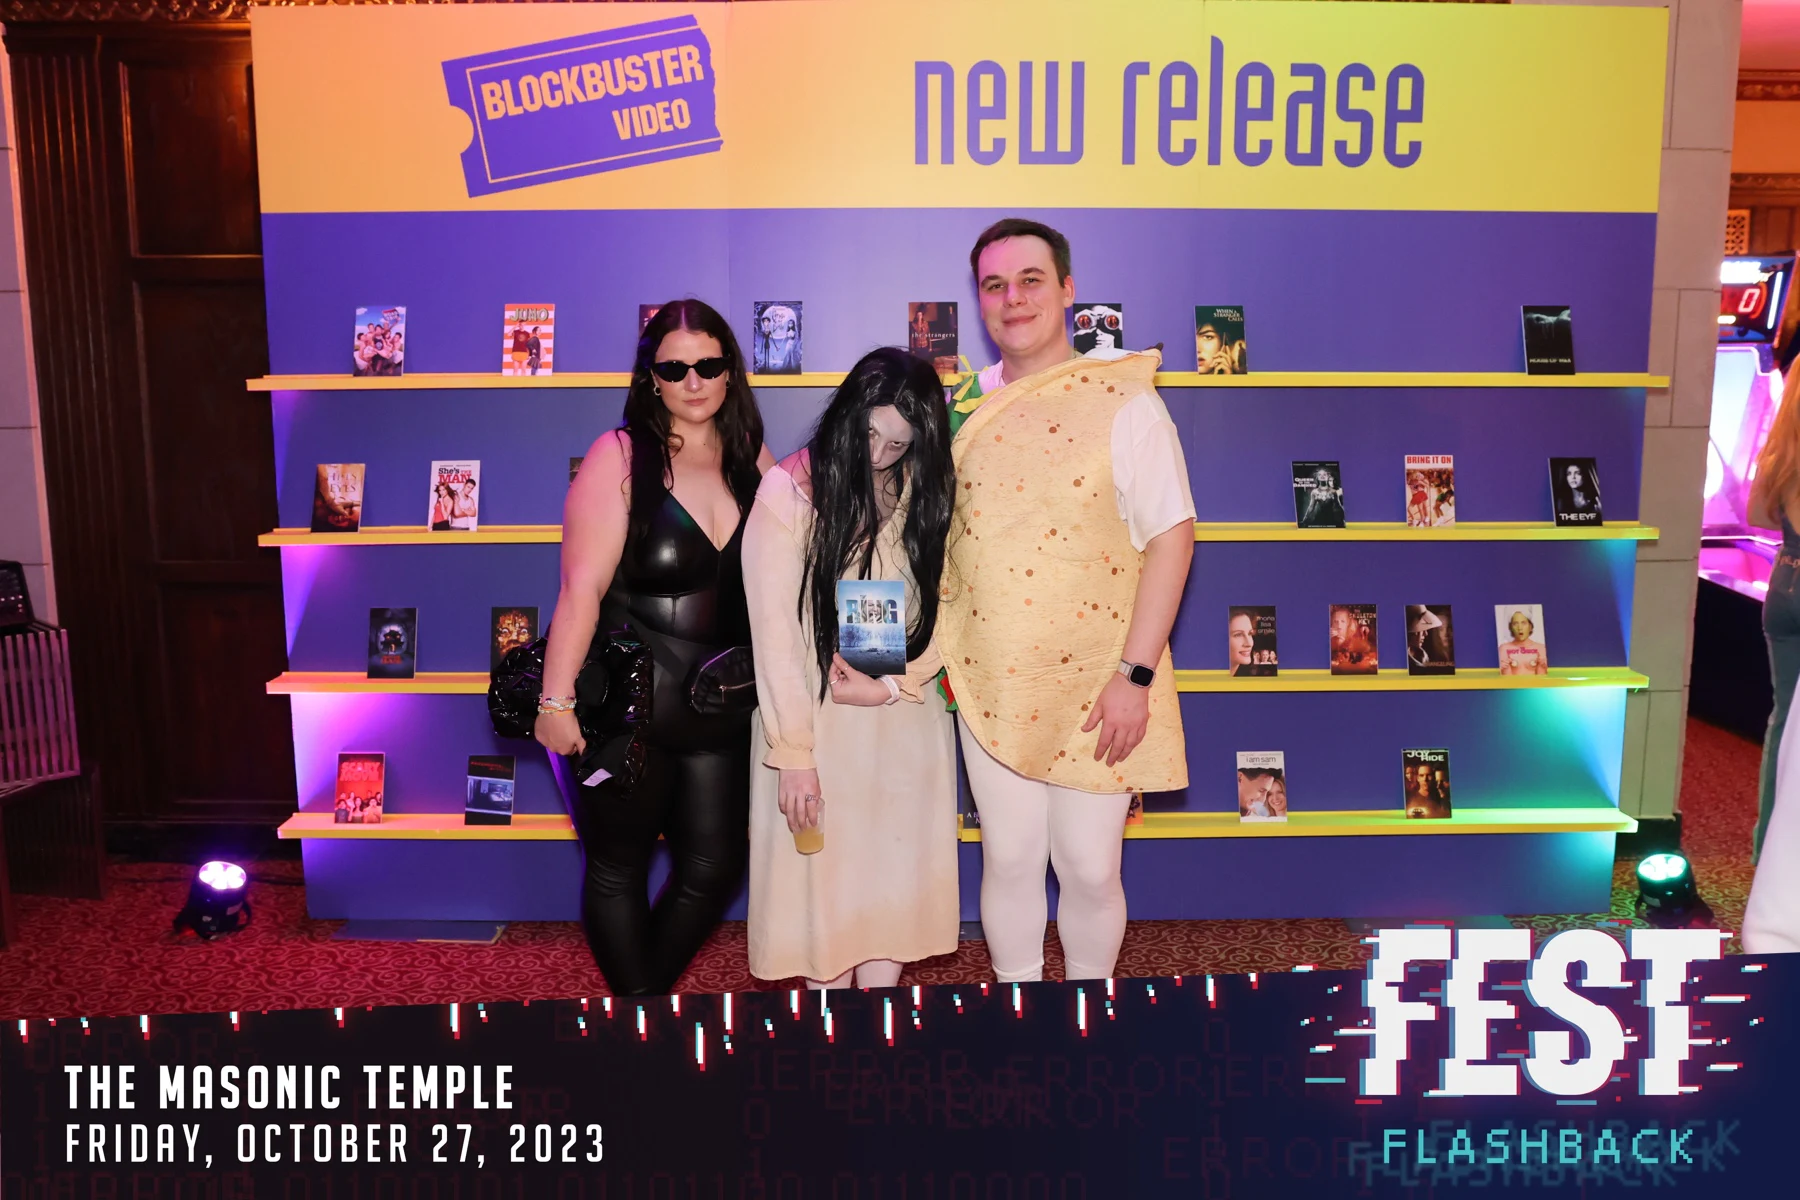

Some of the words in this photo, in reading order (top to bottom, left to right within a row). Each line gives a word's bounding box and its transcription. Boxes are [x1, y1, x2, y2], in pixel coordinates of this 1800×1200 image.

[481, 44, 704, 120] BLOCKBUSTER
[914, 60, 1085, 165] new
[1121, 35, 1425, 168] release
[612, 97, 691, 140] VIDEO
[1737, 288, 1761, 313] 0
[510, 307, 549, 323] JUNO
[1406, 455, 1430, 464] BRING
[1431, 455, 1439, 464] IT
[1440, 455, 1452, 464] ON
[438, 467, 460, 475] She's
[438, 473, 472, 484] MAN
[1559, 512, 1579, 521] THE
[846, 599, 898, 624] RING
[1406, 749, 1430, 758] JOY
[341, 761, 381, 772] SCARY
[339, 771, 379, 782] MOVIE
